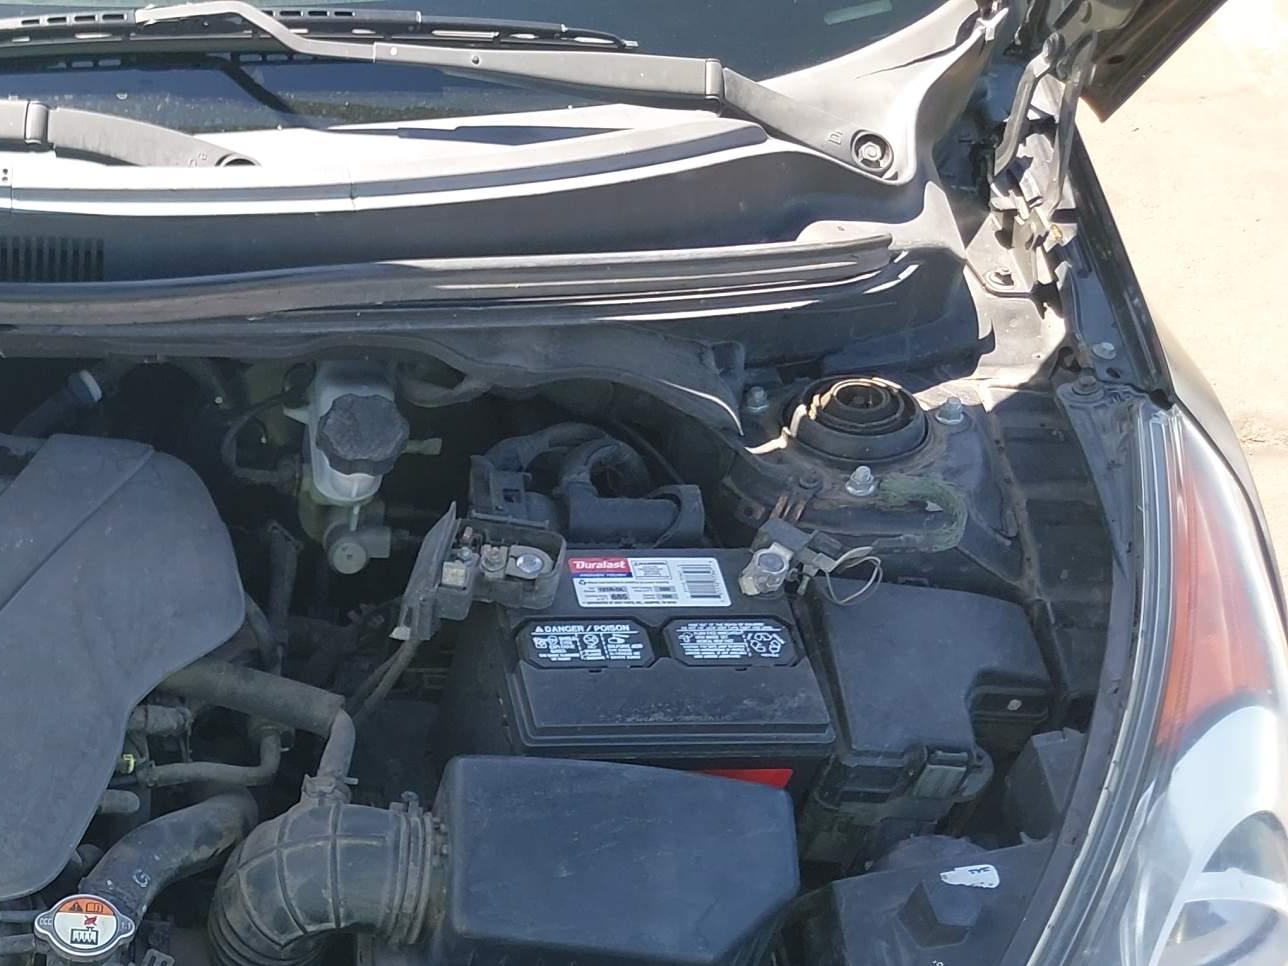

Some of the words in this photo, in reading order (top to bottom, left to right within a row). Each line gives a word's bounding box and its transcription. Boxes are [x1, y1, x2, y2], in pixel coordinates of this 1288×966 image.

[573, 560, 626, 569] Duralast
[544, 625, 584, 633] DANGER
[593, 624, 630, 632] POISON
